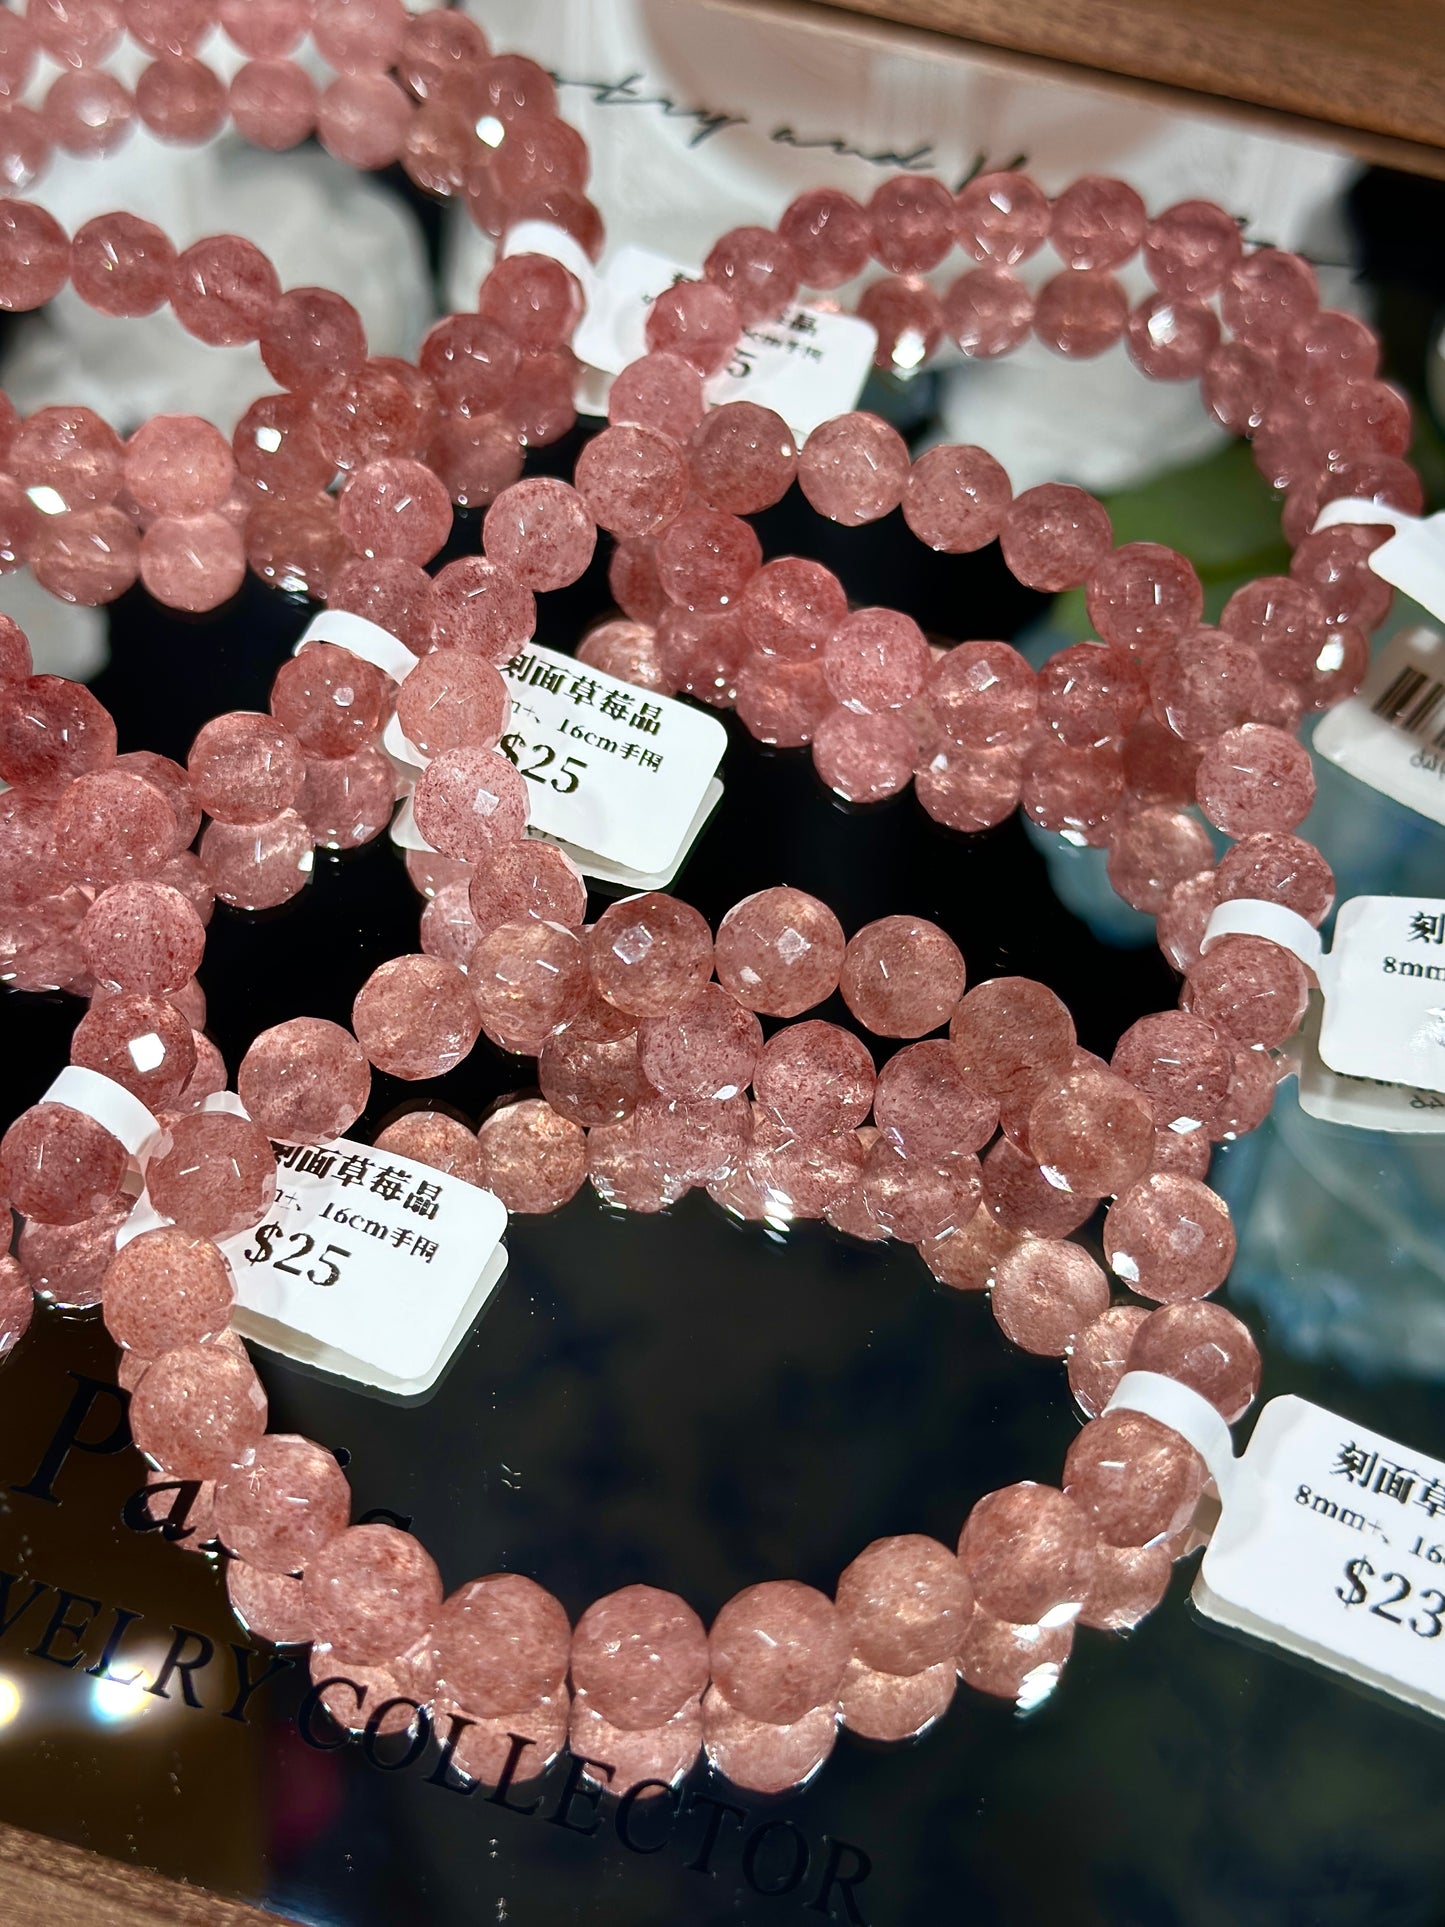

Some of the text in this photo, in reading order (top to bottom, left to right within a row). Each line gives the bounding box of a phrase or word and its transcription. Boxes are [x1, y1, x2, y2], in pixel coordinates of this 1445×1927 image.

[500, 731, 588, 793] $25
[244, 1220, 352, 1287] $25
[1335, 1554, 1445, 1638] $23
[298, 1676, 874, 1926] COLLECTOR
